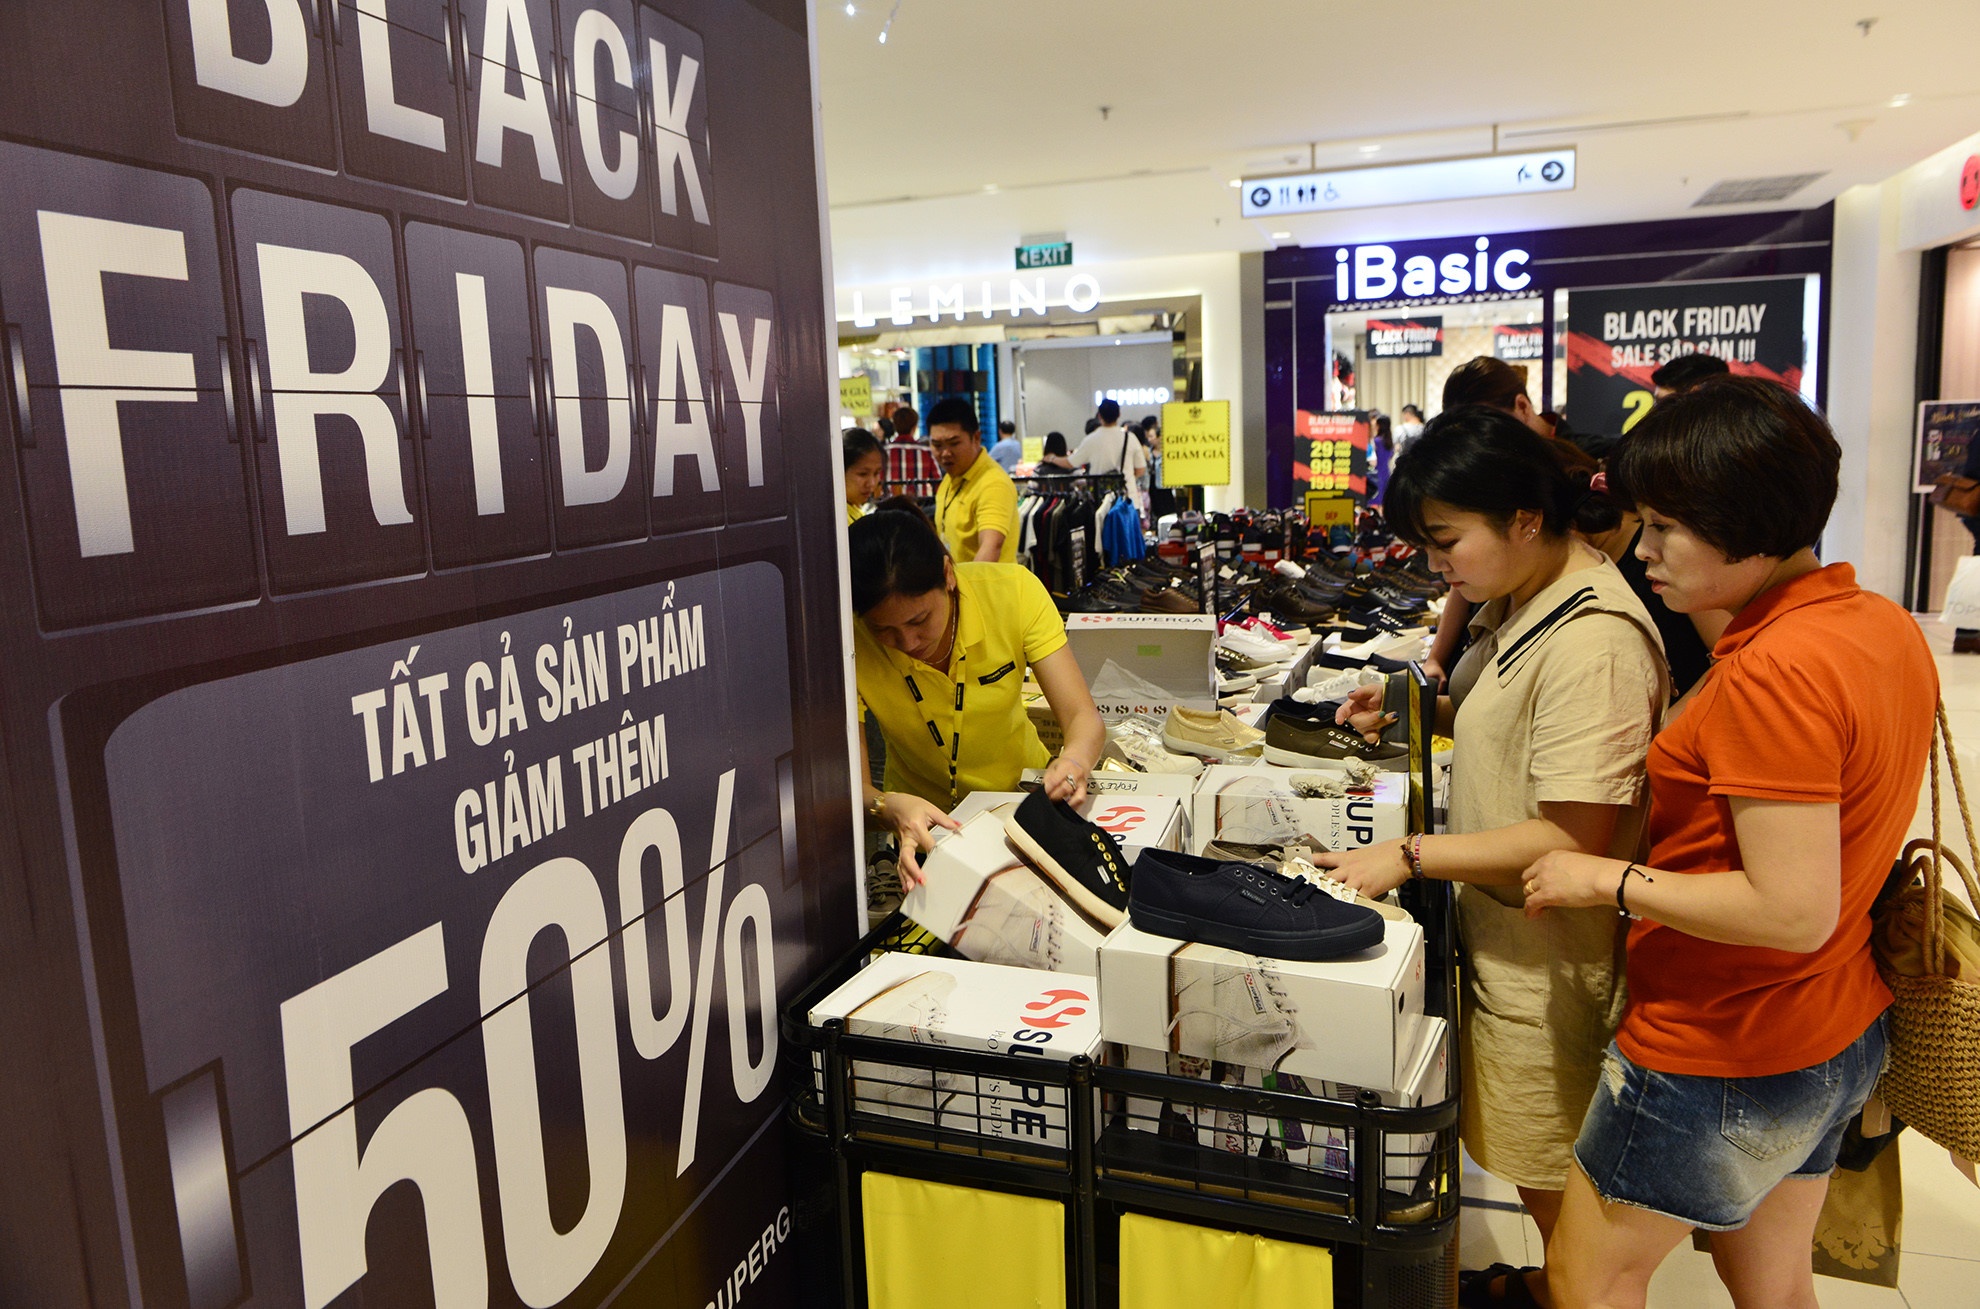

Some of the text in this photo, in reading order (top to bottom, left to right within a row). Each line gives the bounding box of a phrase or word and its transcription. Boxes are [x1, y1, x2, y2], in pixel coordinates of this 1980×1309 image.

[1028, 244, 1070, 267] EXIT
[1335, 236, 1532, 302] iBasic
[852, 272, 1101, 328] LEMINO
[1603, 303, 1767, 342] BLACK FRIDAY
[37, 209, 772, 559] FRIDAY
[1610, 343, 1656, 369] SALE
[1309, 458, 1333, 475] 99
[1310, 440, 1334, 458] 29
[352, 580, 706, 783] TẤT CẢ SẢN PHẨM
[453, 710, 669, 875] GIẢM THÊM
[280, 768, 779, 1309] 50%
